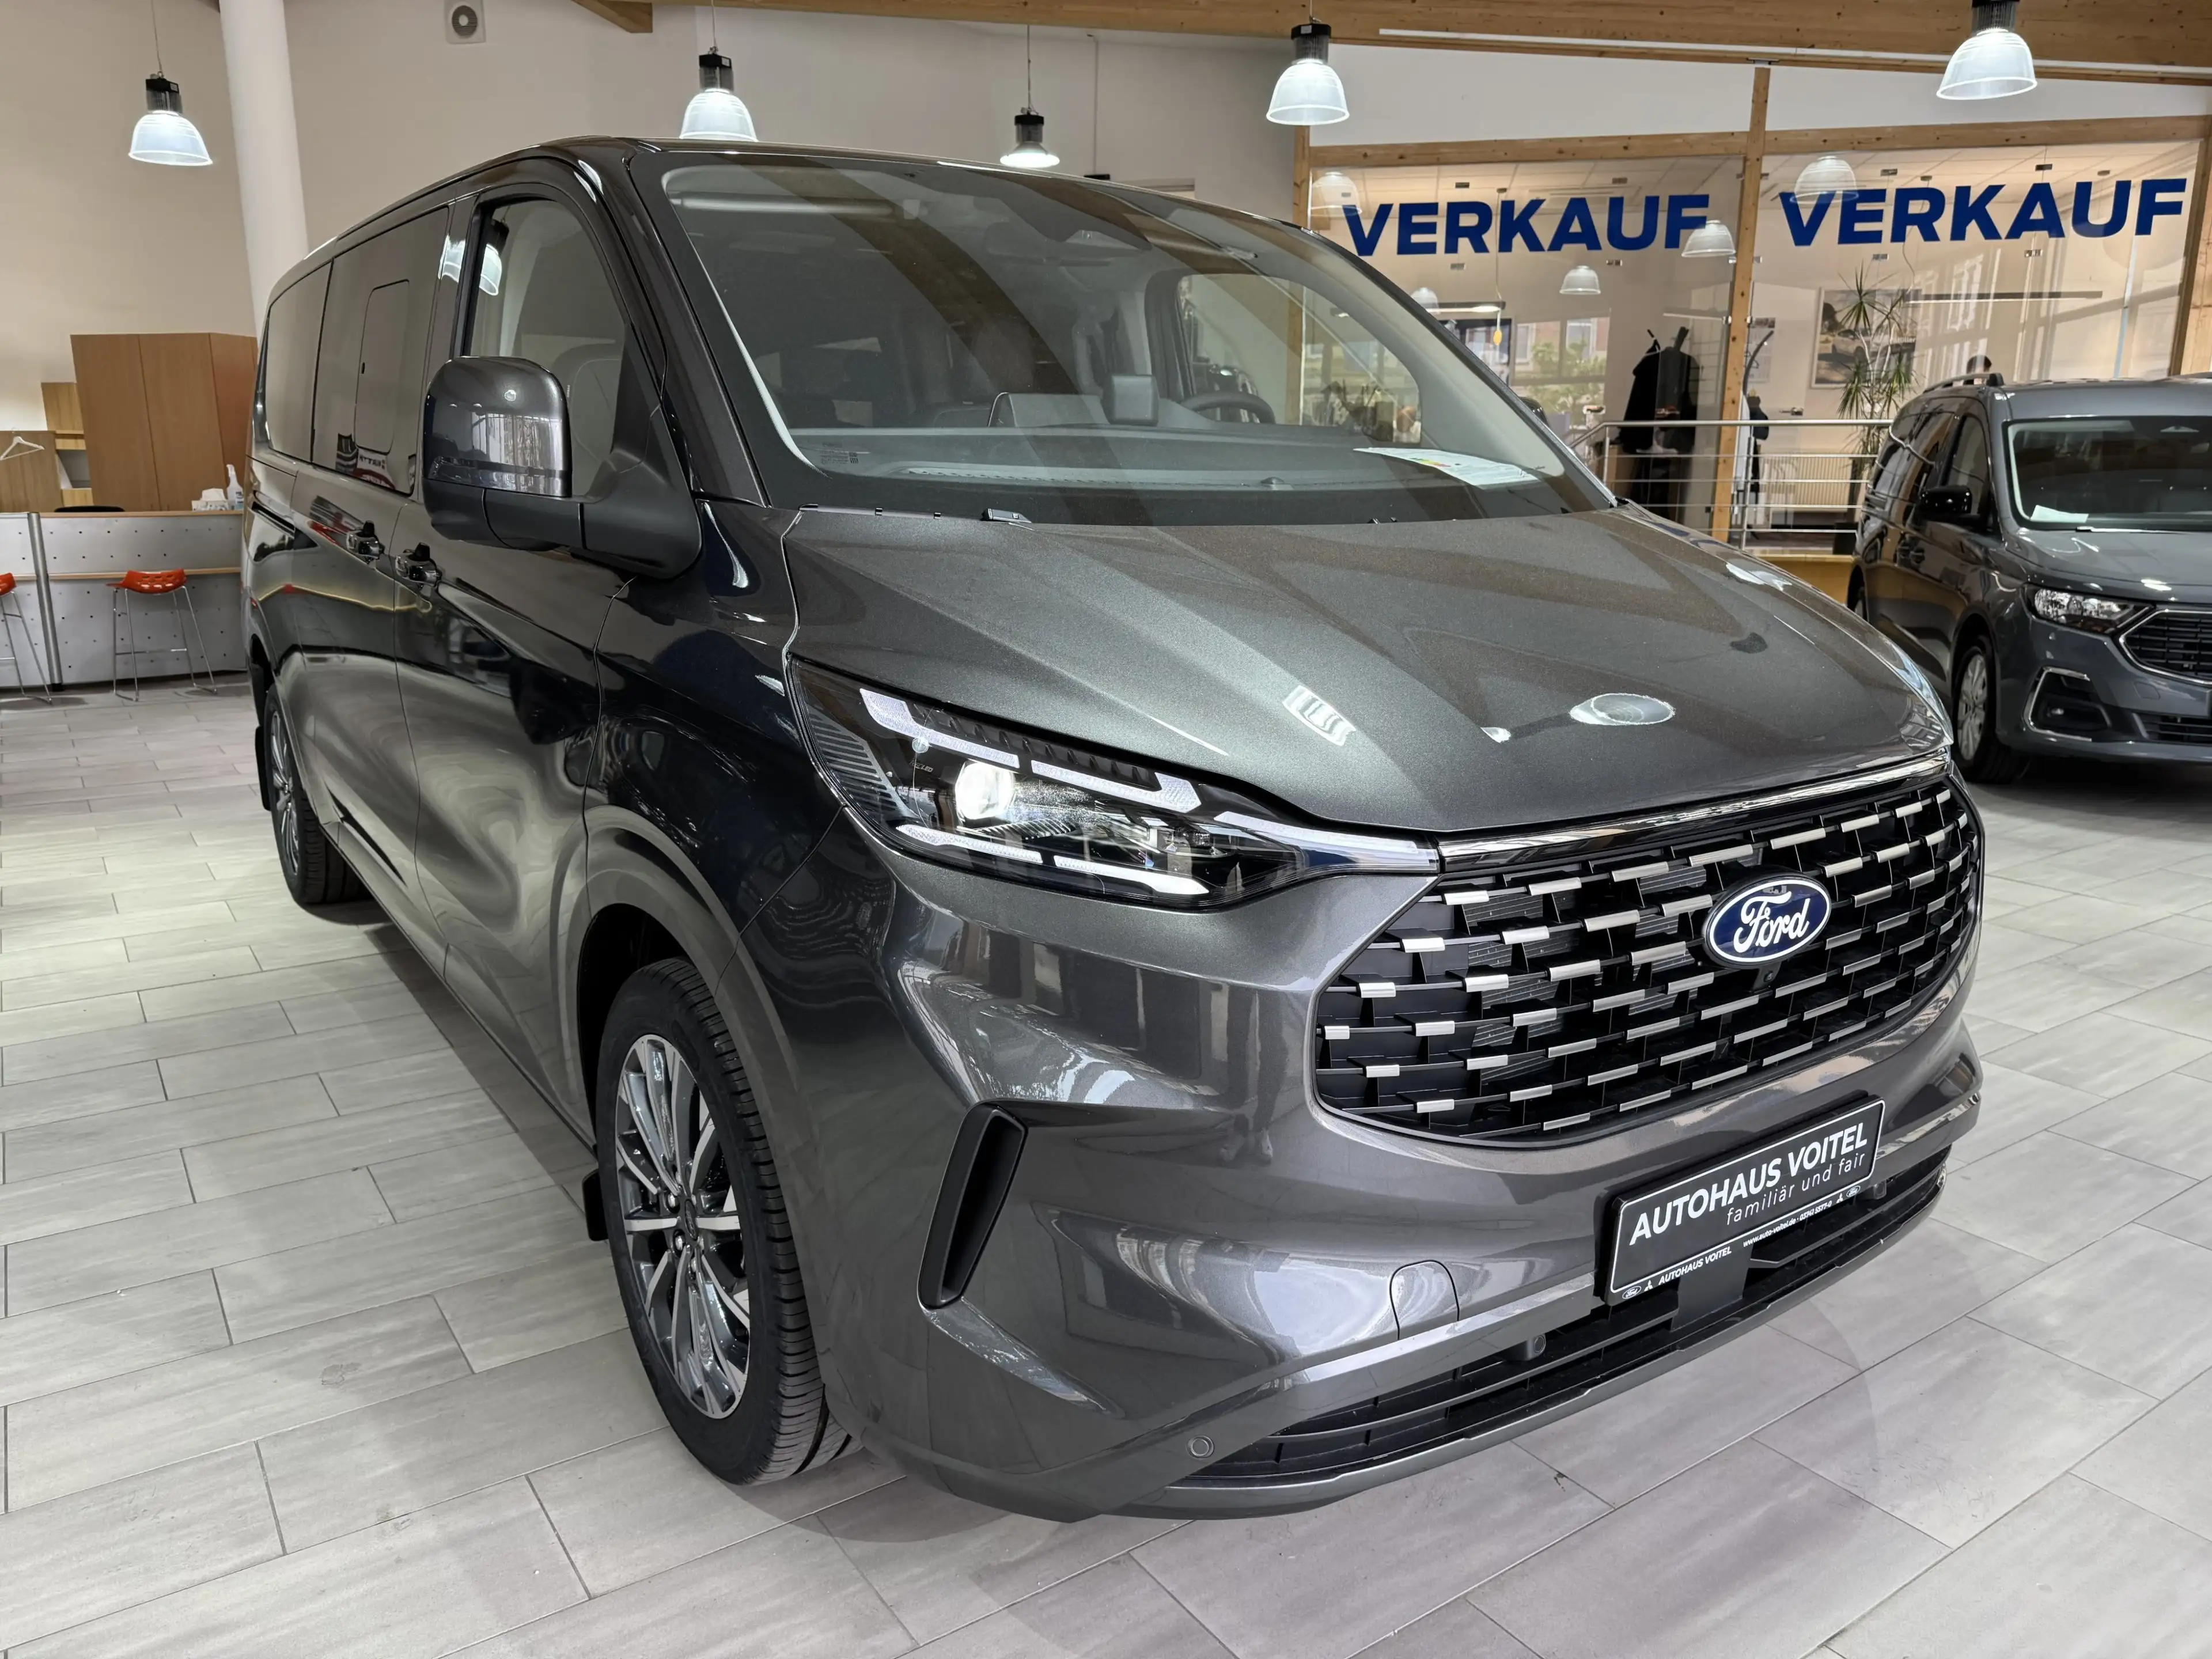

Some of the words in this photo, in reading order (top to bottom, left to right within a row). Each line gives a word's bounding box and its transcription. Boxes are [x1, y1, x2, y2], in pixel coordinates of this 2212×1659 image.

[1342, 194, 1710, 256] VERKAUF
[1778, 177, 2187, 247] VERKAUF
[1733, 891, 1810, 953] Ford
[1629, 1157, 1782, 1246] AUTOHAUS
[1788, 1122, 1868, 1177] VOITEL
[1727, 1184, 1795, 1225] familiär
[1802, 1164, 1832, 1191] und
[1839, 1153, 1865, 1175] fair
[1743, 1217, 1797, 1247] www.auto-voitel.de
[1658, 1258, 1703, 1286] AUTOHAUS
[1705, 1246, 1732, 1264] VOITEL
